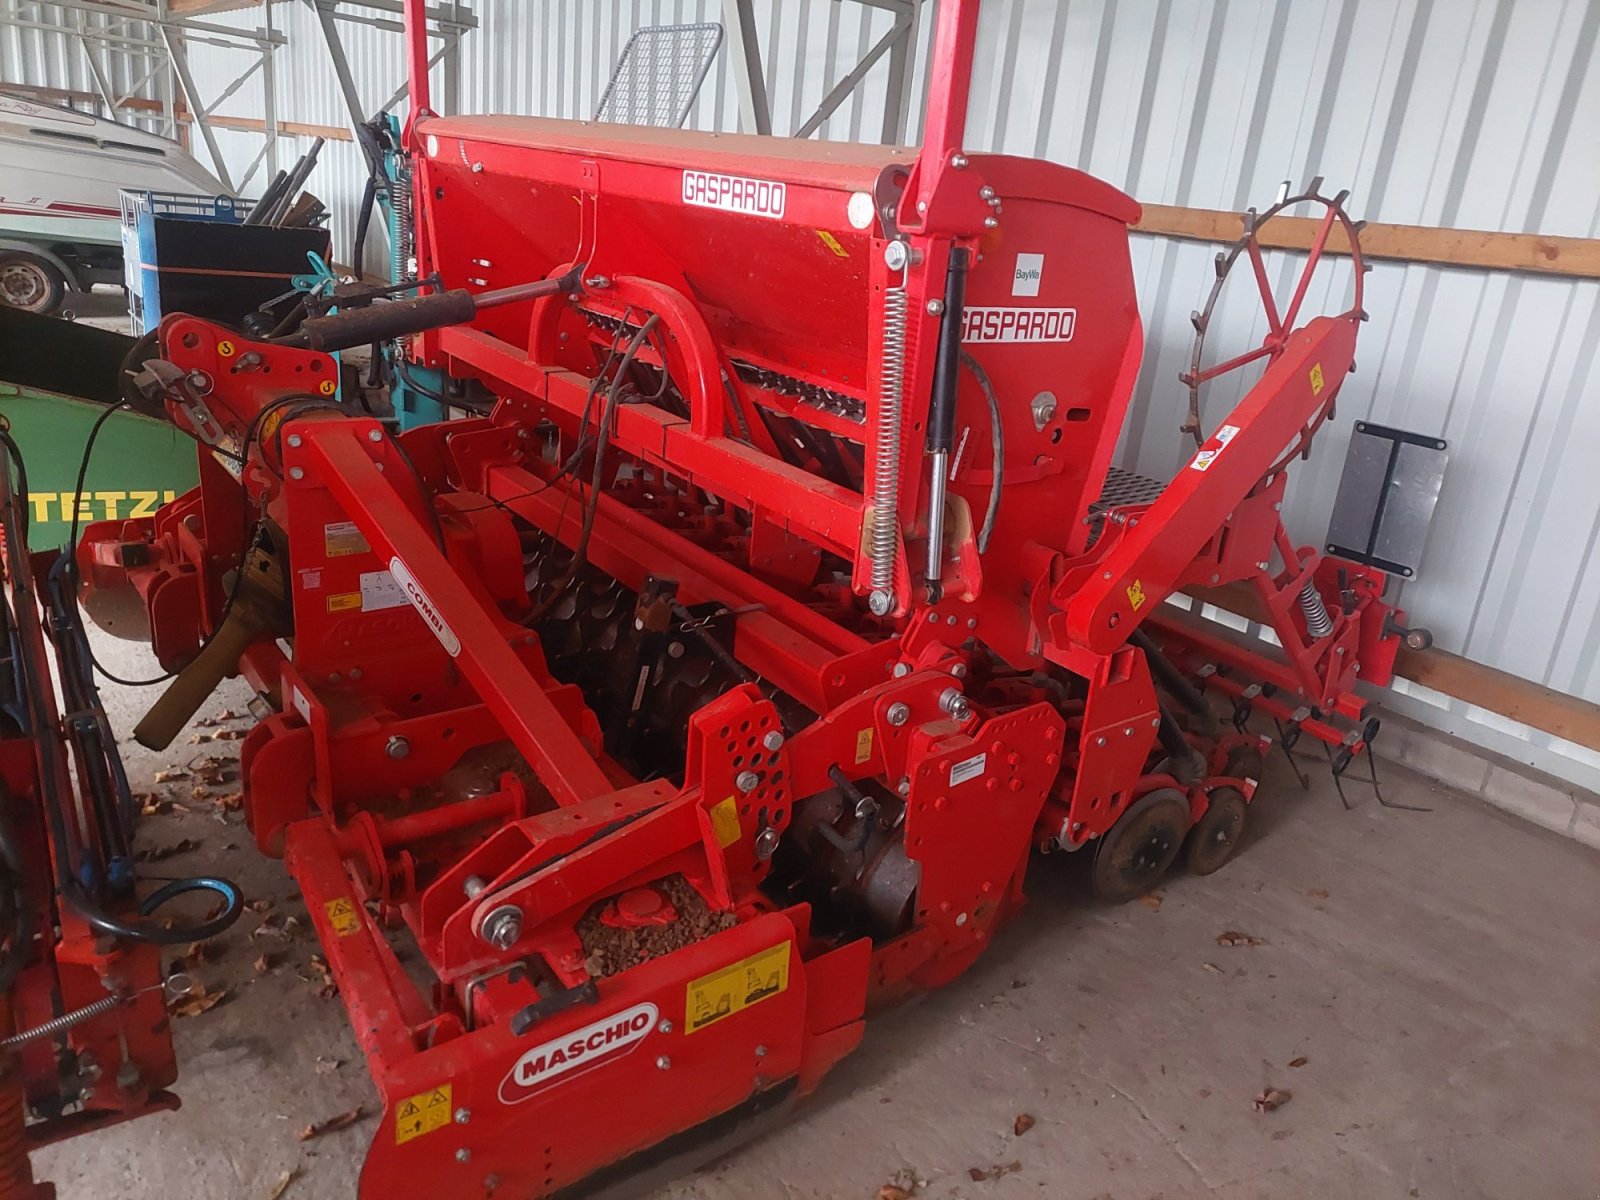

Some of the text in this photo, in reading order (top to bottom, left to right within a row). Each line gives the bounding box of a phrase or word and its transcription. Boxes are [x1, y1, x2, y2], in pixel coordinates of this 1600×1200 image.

[685, 173, 783, 215] GASPARDO
[1016, 268, 1040, 281] BayWa
[407, 582, 443, 633] COMBI
[523, 1012, 650, 1080] MASCHIO
